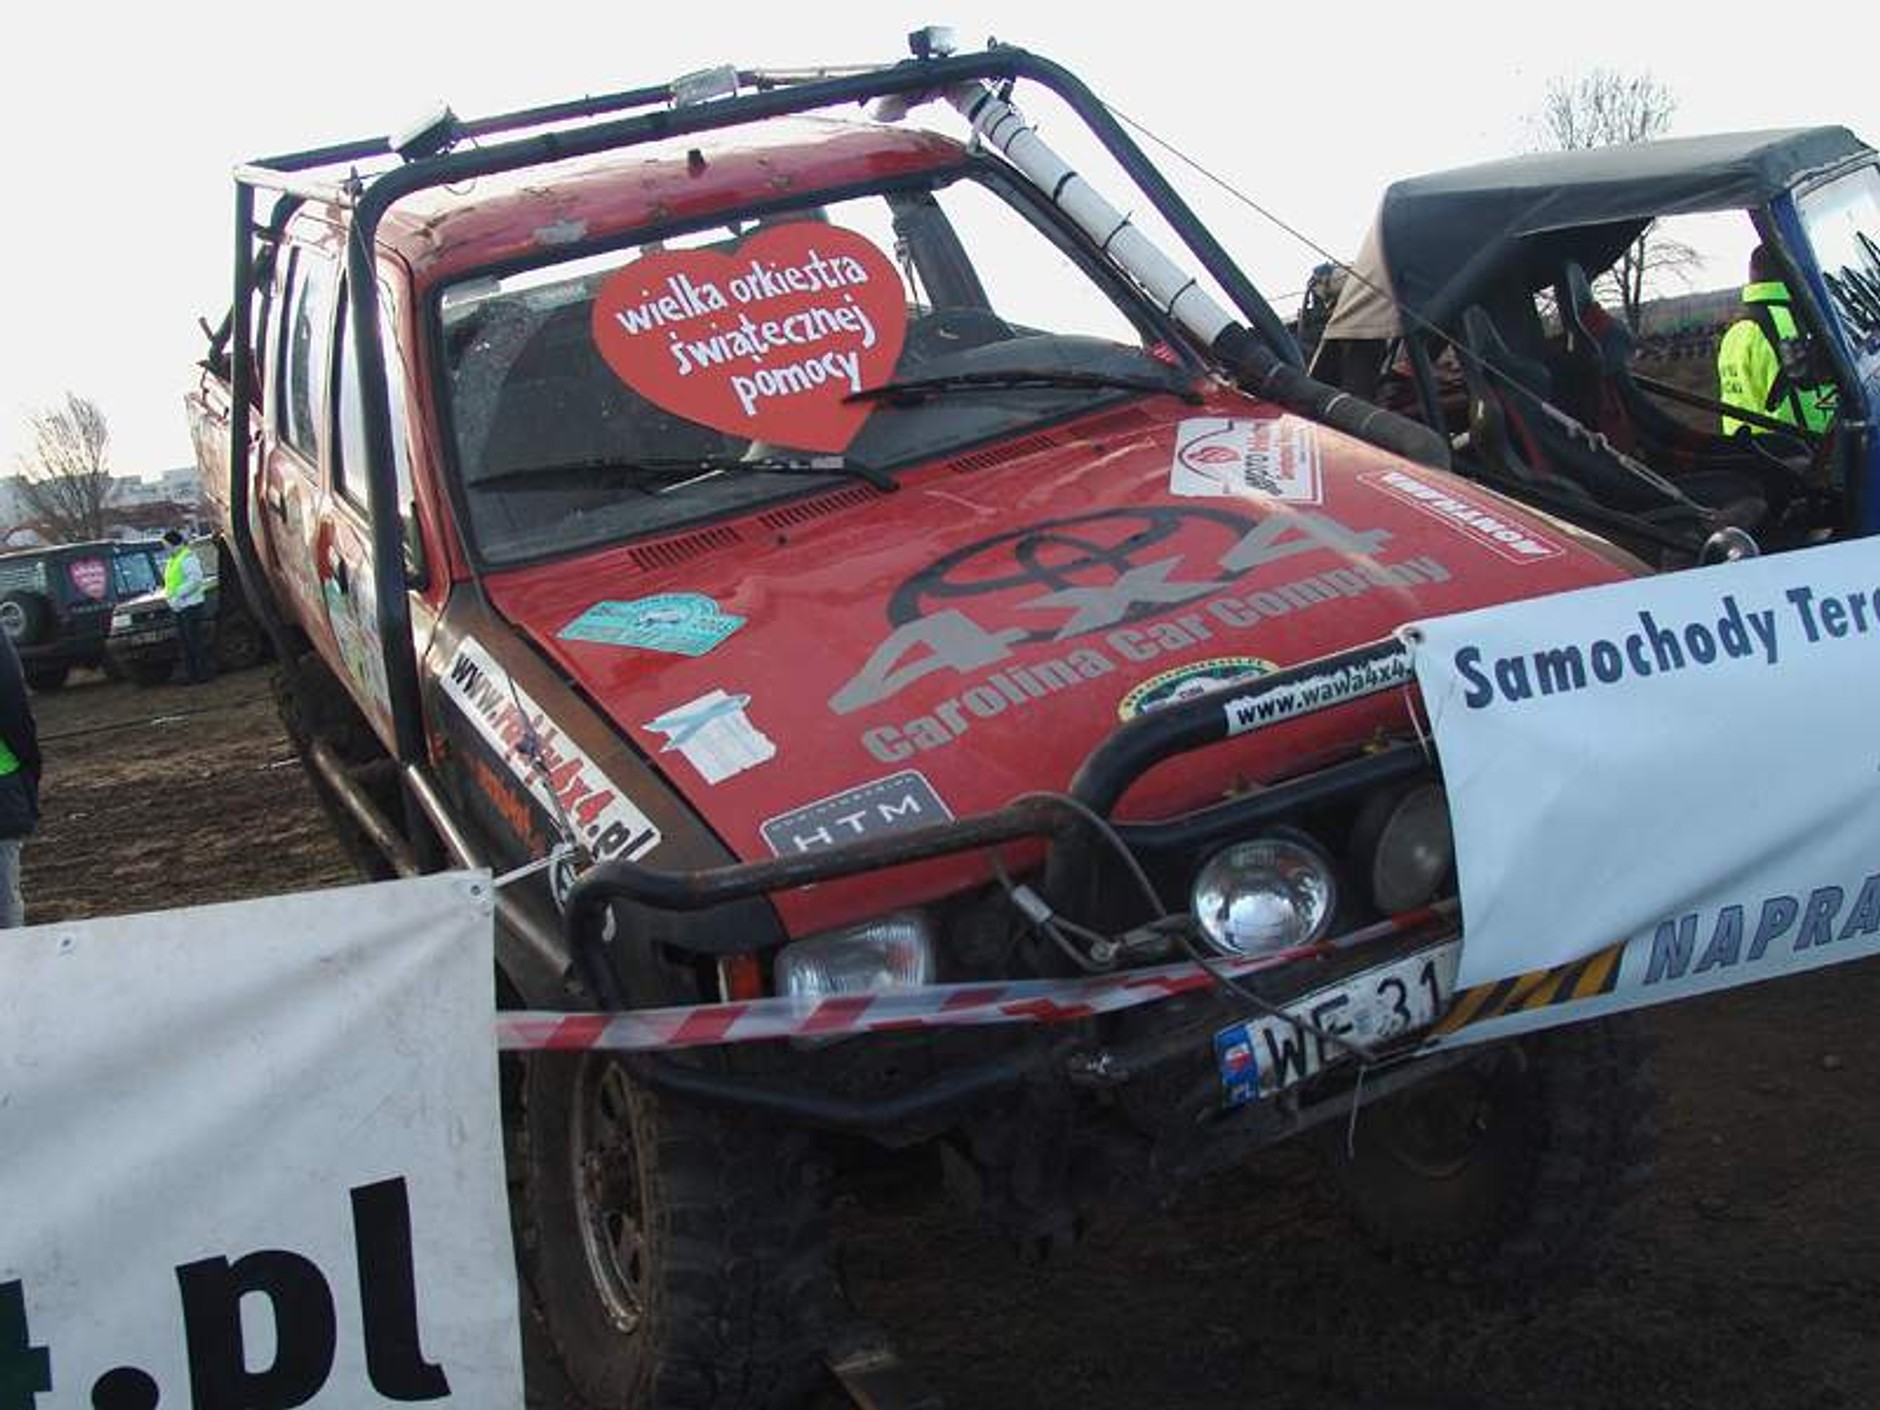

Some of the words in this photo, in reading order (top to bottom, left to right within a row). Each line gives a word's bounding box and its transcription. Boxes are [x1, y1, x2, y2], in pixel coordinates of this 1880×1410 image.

[616, 272, 729, 335] wielka
[730, 249, 869, 301] orkiestra
[669, 294, 876, 376] świątecznej
[731, 350, 862, 416] pomocy
[862, 647, 1116, 763] Carolina
[1105, 611, 1213, 661] Car
[1206, 556, 1452, 627] Company
[1455, 596, 1777, 709] Samochody
[793, 794, 922, 852] HTM
[1642, 873, 1880, 986] NAPRA
